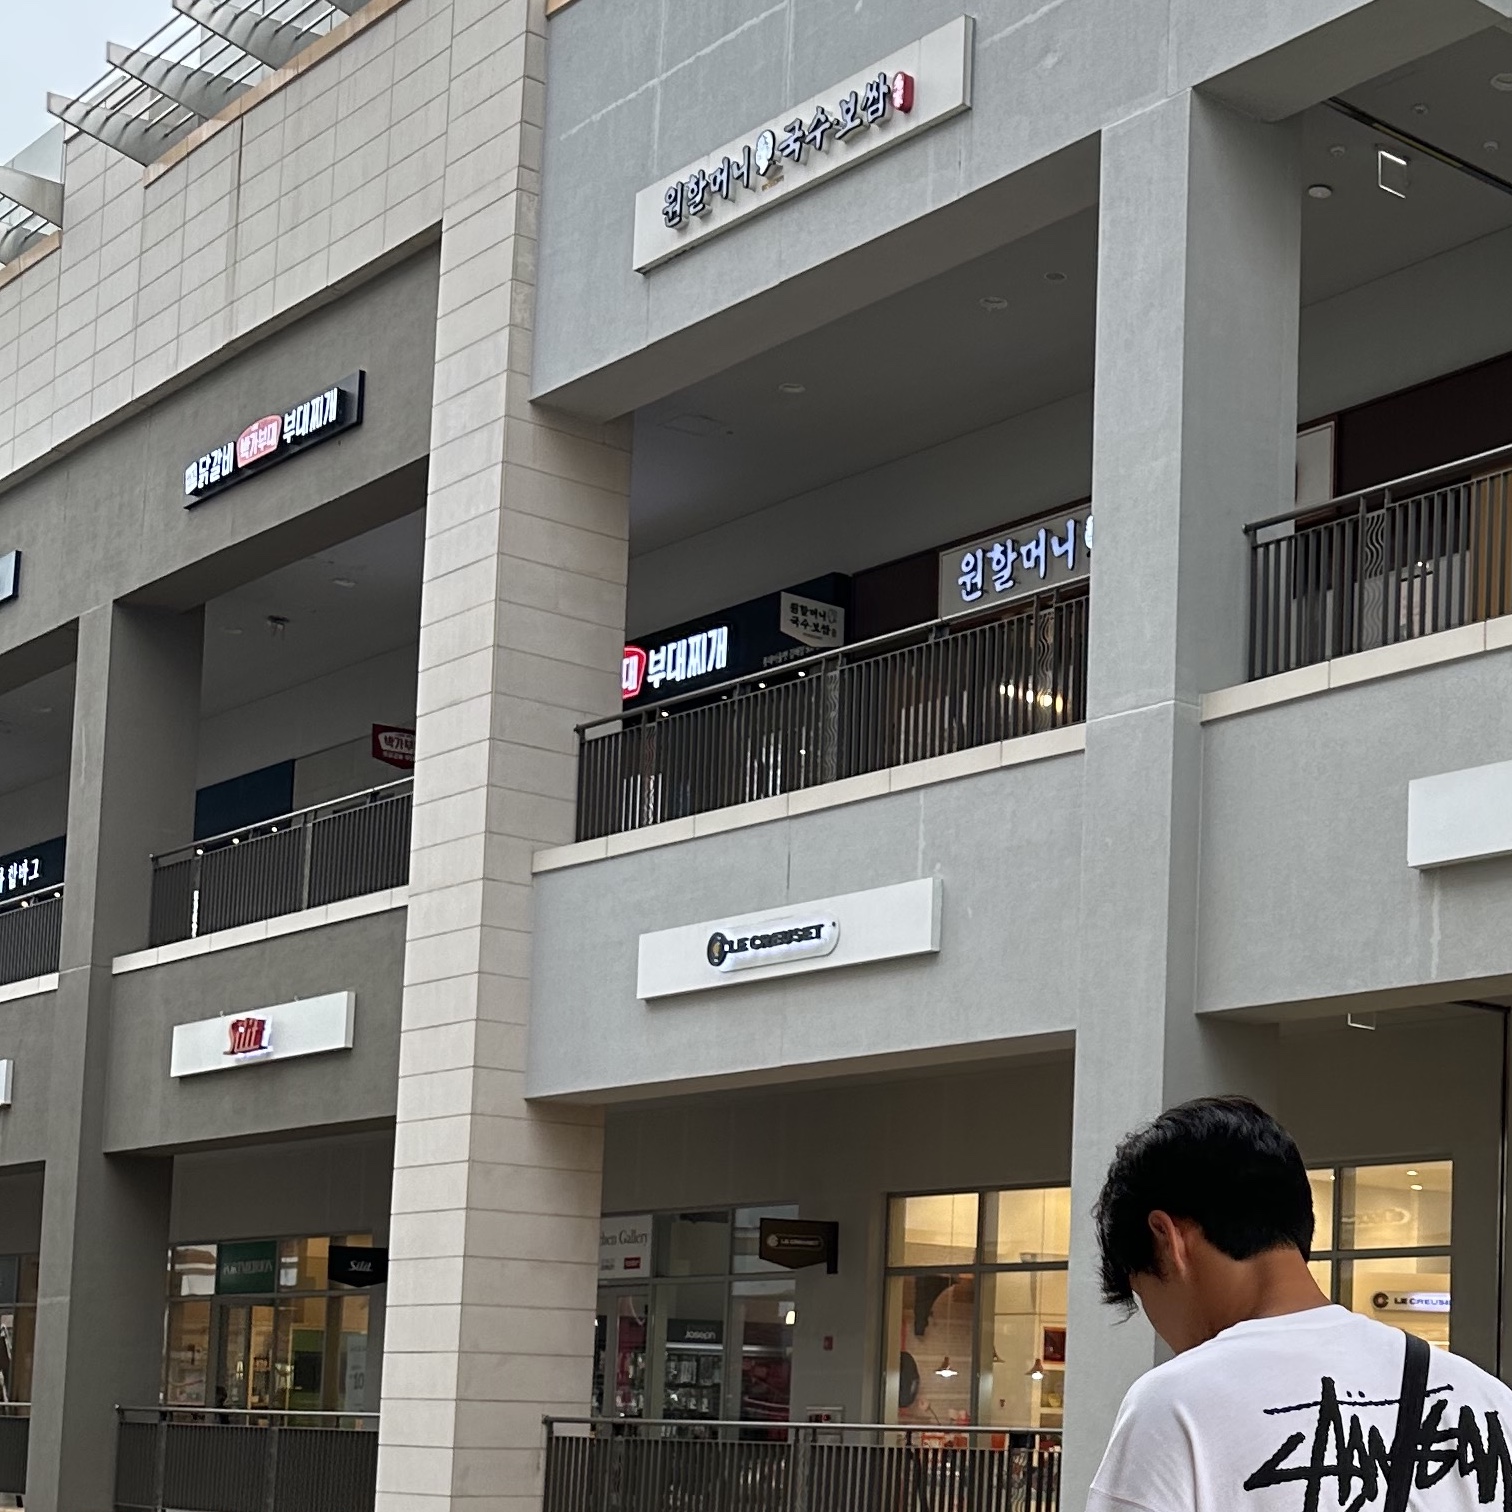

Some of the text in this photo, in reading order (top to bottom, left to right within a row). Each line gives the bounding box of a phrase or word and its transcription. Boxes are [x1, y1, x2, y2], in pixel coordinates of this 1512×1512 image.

[662, 145, 752, 230] 원할머니
[197, 440, 235, 489] 닭갈비
[282, 387, 339, 444] 부대찌개
[957, 518, 1077, 603] 원할머니
[622, 655, 639, 691] 대
[646, 625, 729, 689] 부대찌개
[727, 924, 825, 953] LE CREUSET
[1394, 1297, 1407, 1305] LE
